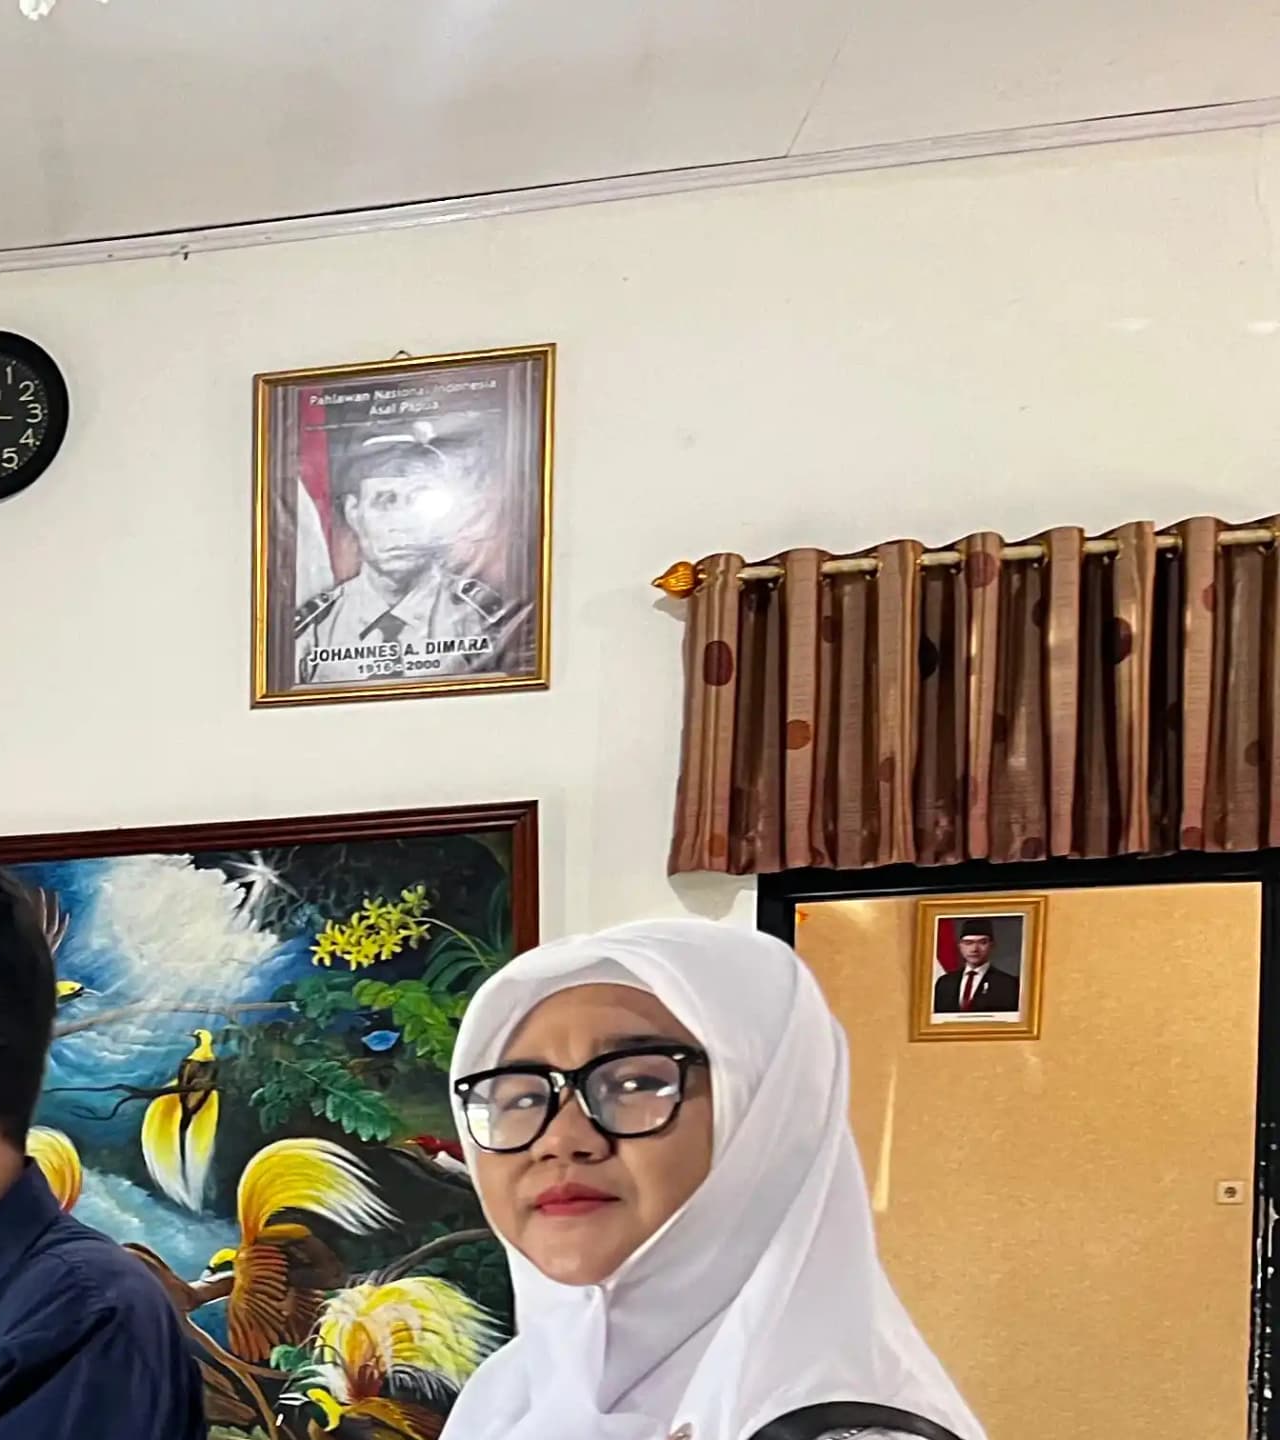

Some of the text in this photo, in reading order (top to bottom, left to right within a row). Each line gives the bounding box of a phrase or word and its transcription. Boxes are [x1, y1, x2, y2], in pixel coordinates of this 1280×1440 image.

[6, 366, 12, 385] 1
[19, 381, 34, 401] 2
[310, 392, 371, 406] Pahlawan
[26, 404, 42, 423] 3
[369, 400, 439, 415] Asal Papua
[19, 428, 34, 446] 4
[2, 448, 18, 468] 5
[309, 637, 491, 663] JOHANNES A. DIMARA
[357, 660, 392, 675] 1916
[406, 659, 441, 672] 2000
